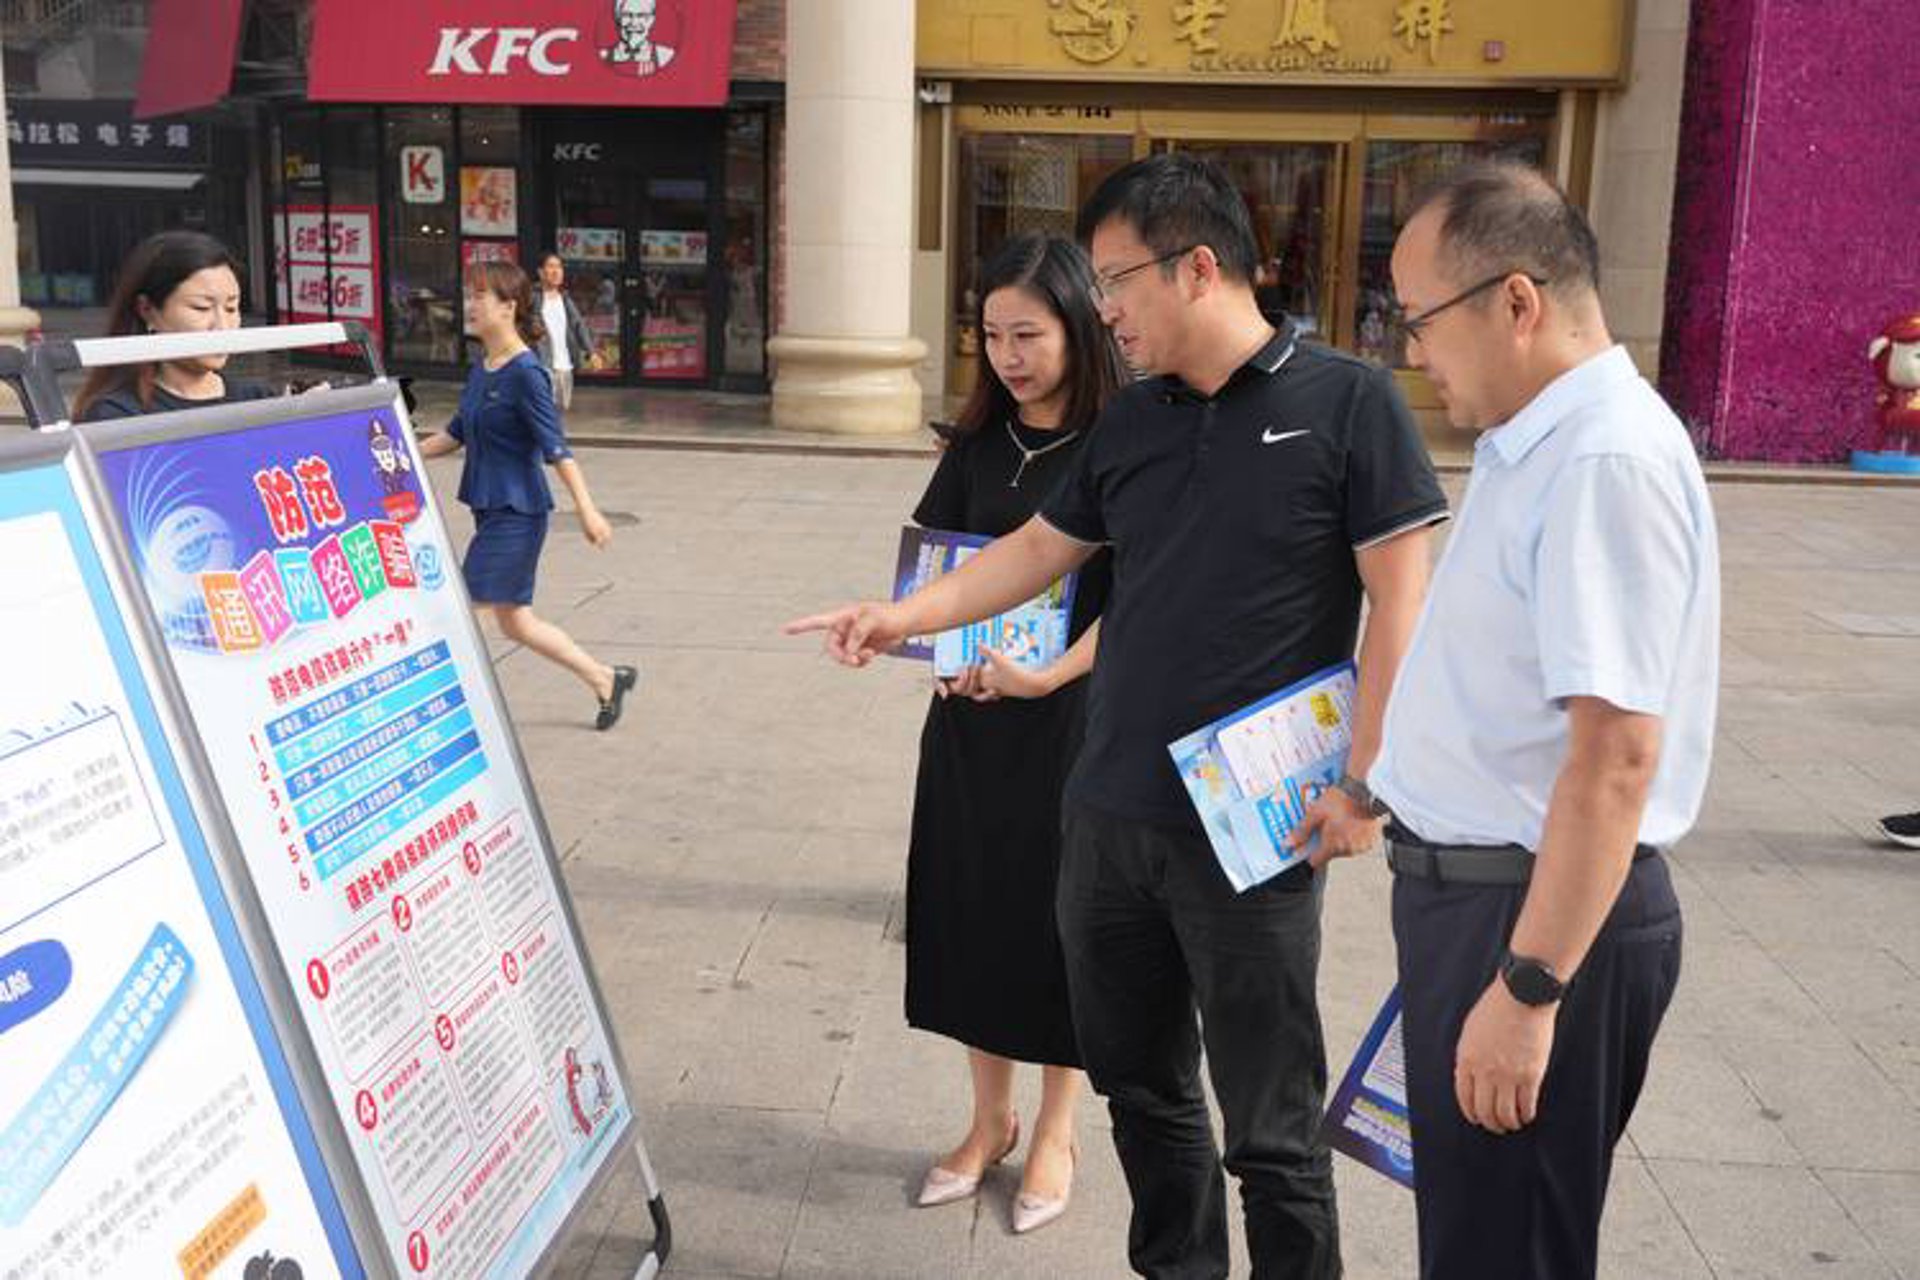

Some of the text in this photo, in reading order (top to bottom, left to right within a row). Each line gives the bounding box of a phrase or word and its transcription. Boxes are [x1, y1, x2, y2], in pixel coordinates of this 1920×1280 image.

[426, 27, 579, 76] KFC
[553, 143, 601, 161] KFC
[408, 152, 434, 191] K
[254, 455, 347, 543] 防范
[258, 759, 270, 782] 2
[269, 788, 280, 810] 3
[287, 842, 300, 864] 5
